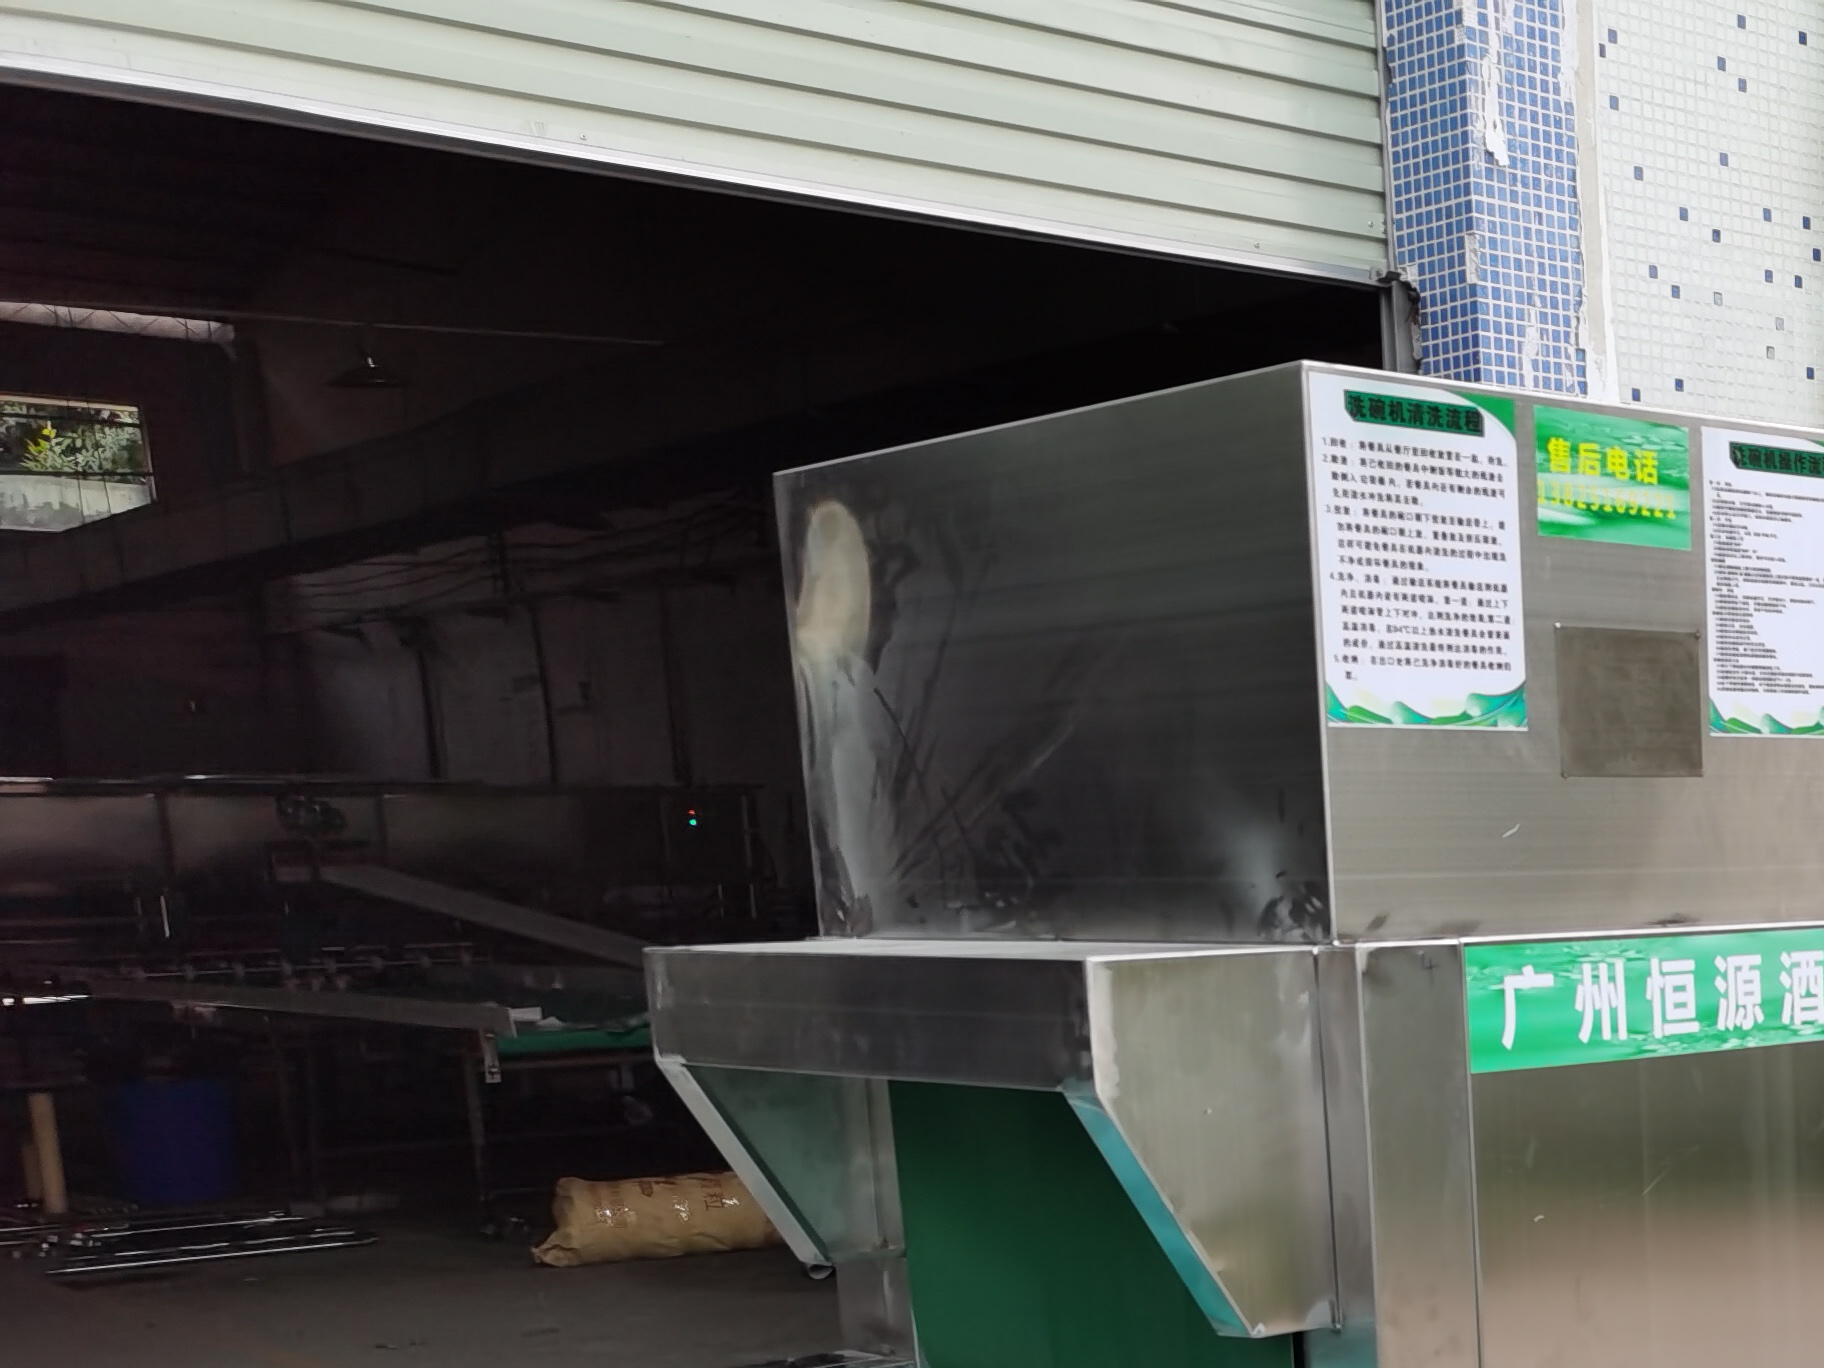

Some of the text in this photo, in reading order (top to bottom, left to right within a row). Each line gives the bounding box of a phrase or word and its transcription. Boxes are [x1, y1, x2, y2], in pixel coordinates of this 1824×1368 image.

[1347, 394, 1481, 434] 洗碗机清洗流程
[1547, 437, 1659, 485] 售后电话
